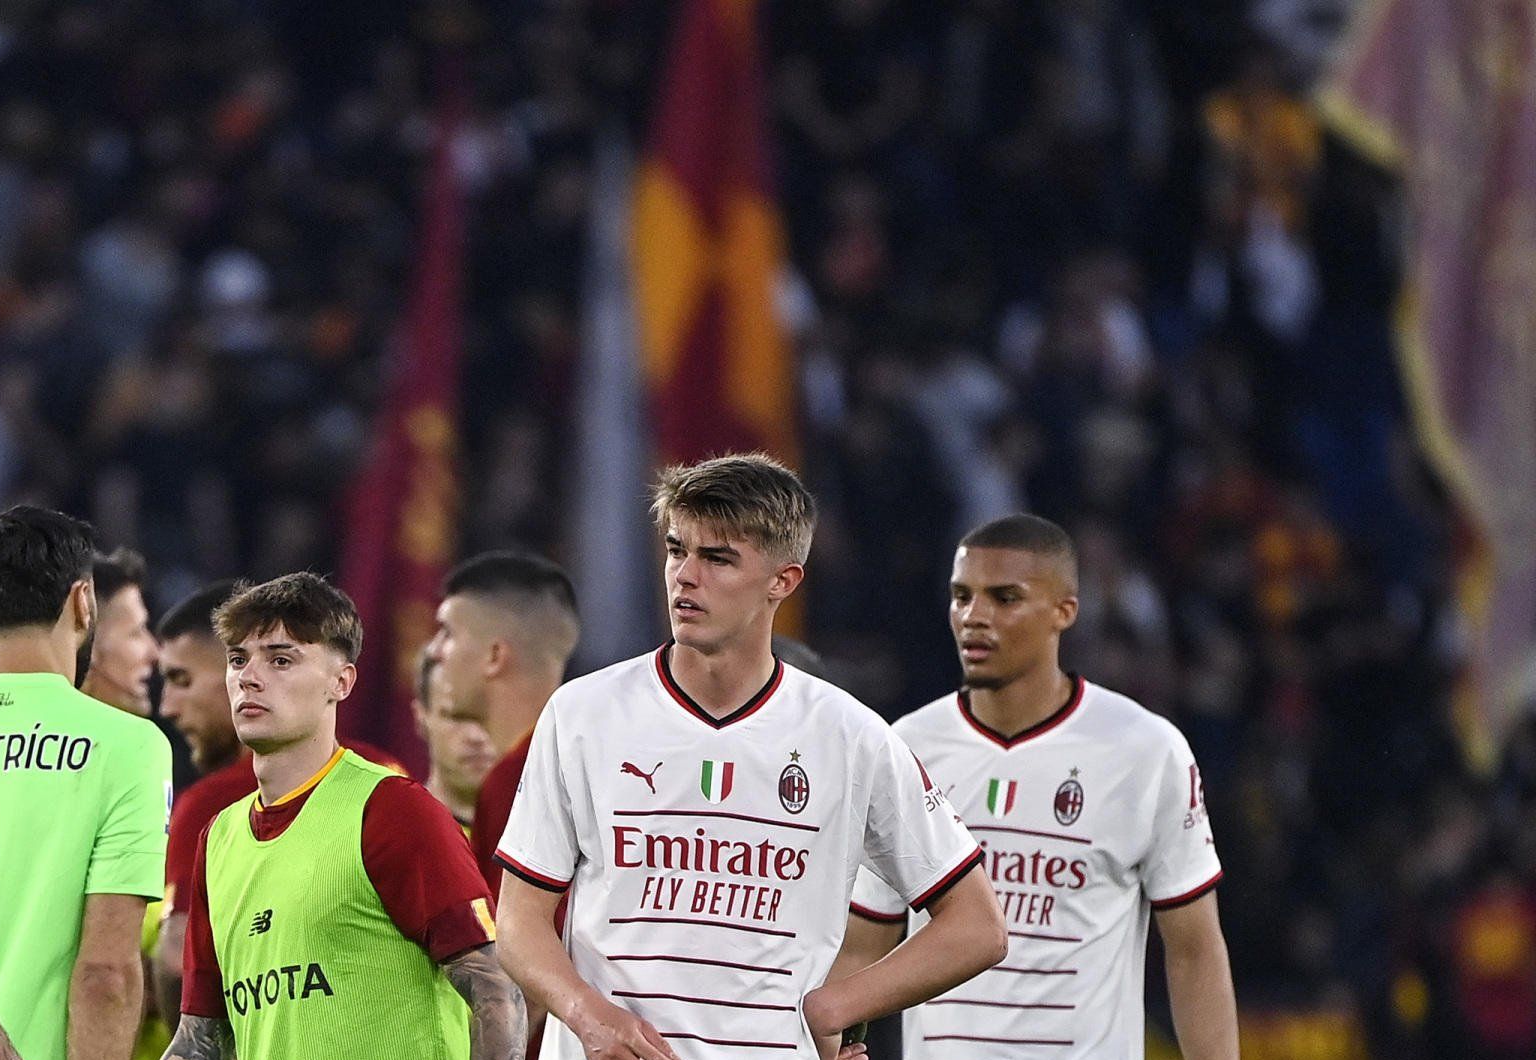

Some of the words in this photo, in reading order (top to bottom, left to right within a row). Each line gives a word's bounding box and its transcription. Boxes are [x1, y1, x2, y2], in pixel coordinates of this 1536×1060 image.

[611, 825, 810, 881] Emirates
[640, 876, 684, 911] FLY
[690, 880, 783, 922] BETTER
